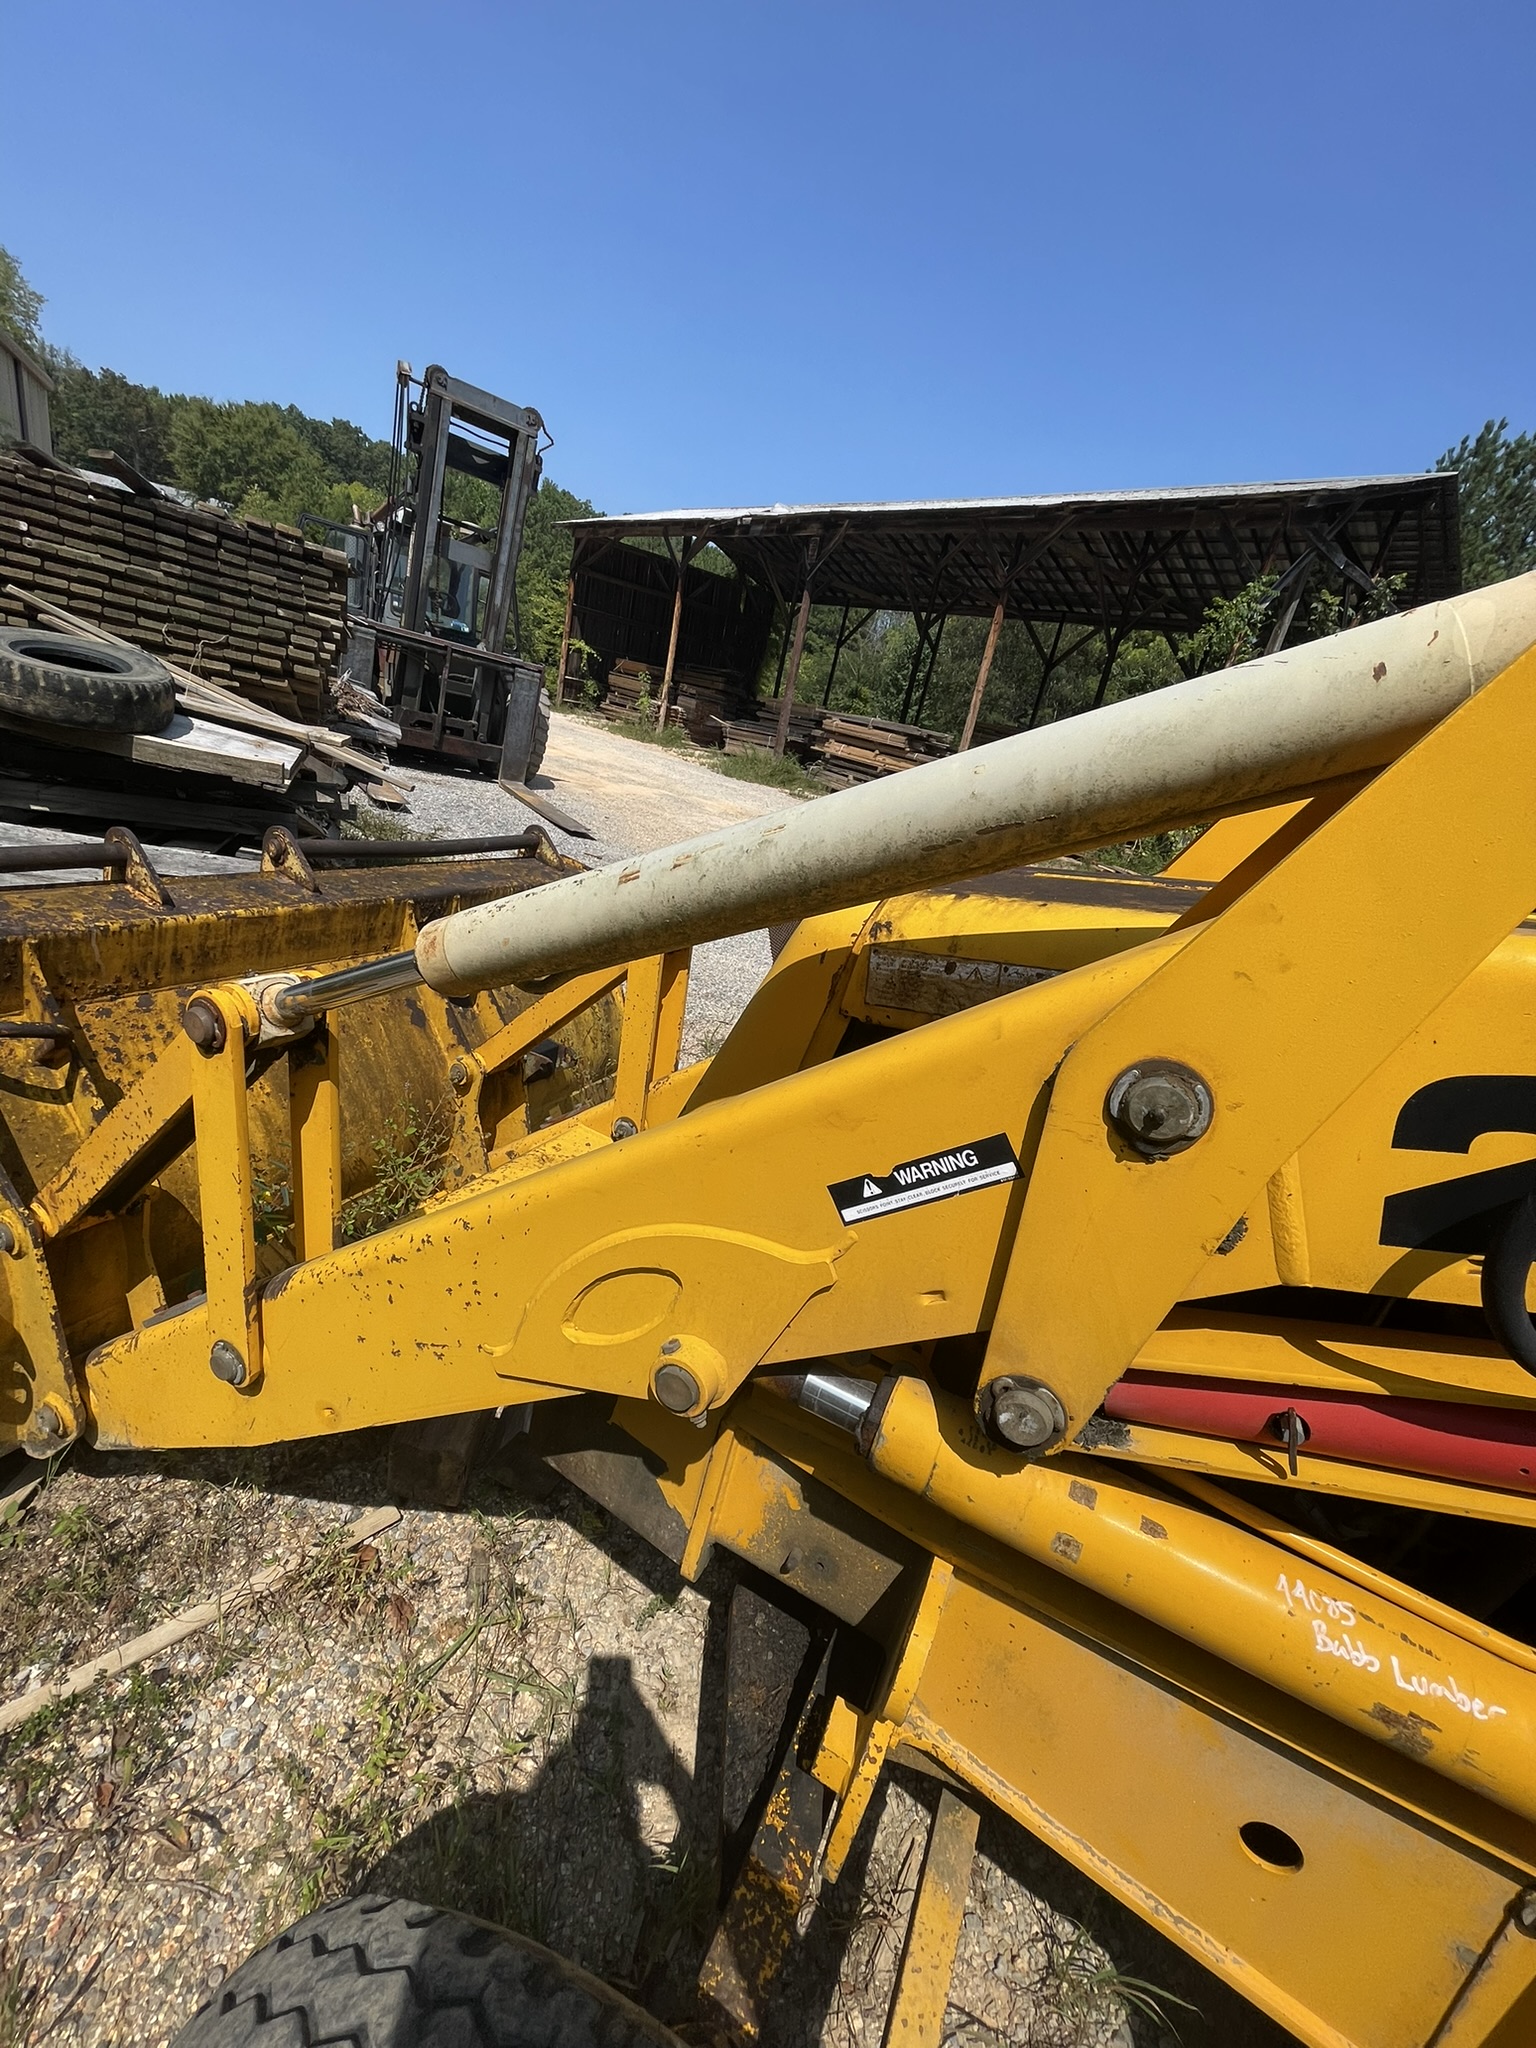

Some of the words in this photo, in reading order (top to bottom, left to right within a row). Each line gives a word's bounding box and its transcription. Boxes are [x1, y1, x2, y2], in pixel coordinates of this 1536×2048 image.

[893, 1149, 979, 1186] WARNING
[942, 1180, 967, 1191] SECURELY
[967, 1176, 978, 1184] FOR
[980, 1170, 1001, 1180] SERVICE
[1390, 1655, 1507, 1720] Lumber
